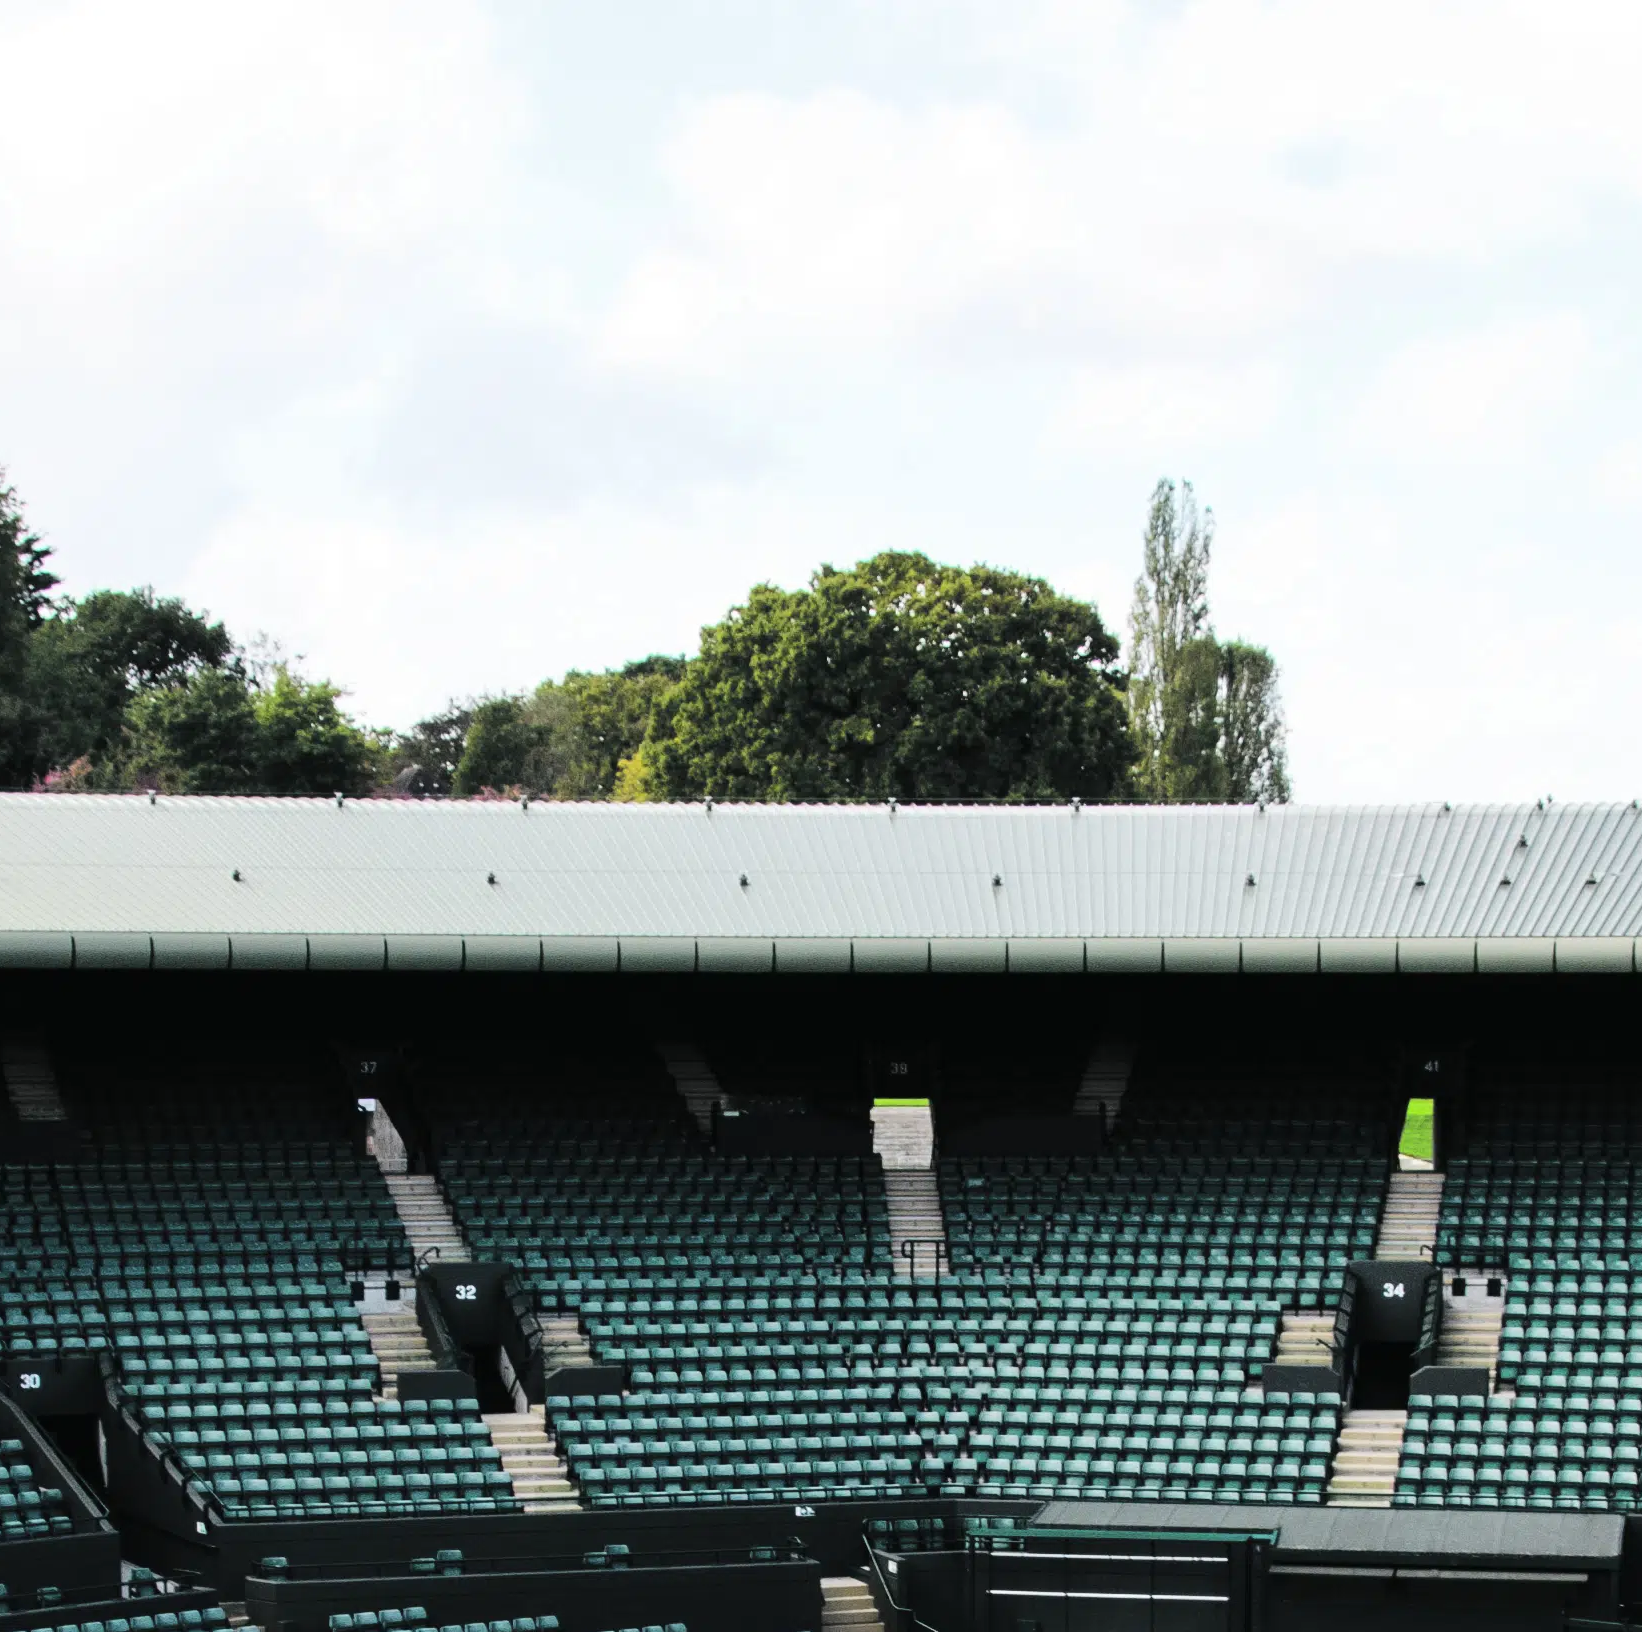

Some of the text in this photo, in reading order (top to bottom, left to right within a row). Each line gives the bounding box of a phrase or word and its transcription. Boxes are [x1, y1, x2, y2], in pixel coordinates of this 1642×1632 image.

[455, 1284, 477, 1300] 32
[1382, 1282, 1406, 1298] 34
[19, 1373, 41, 1389] 30
